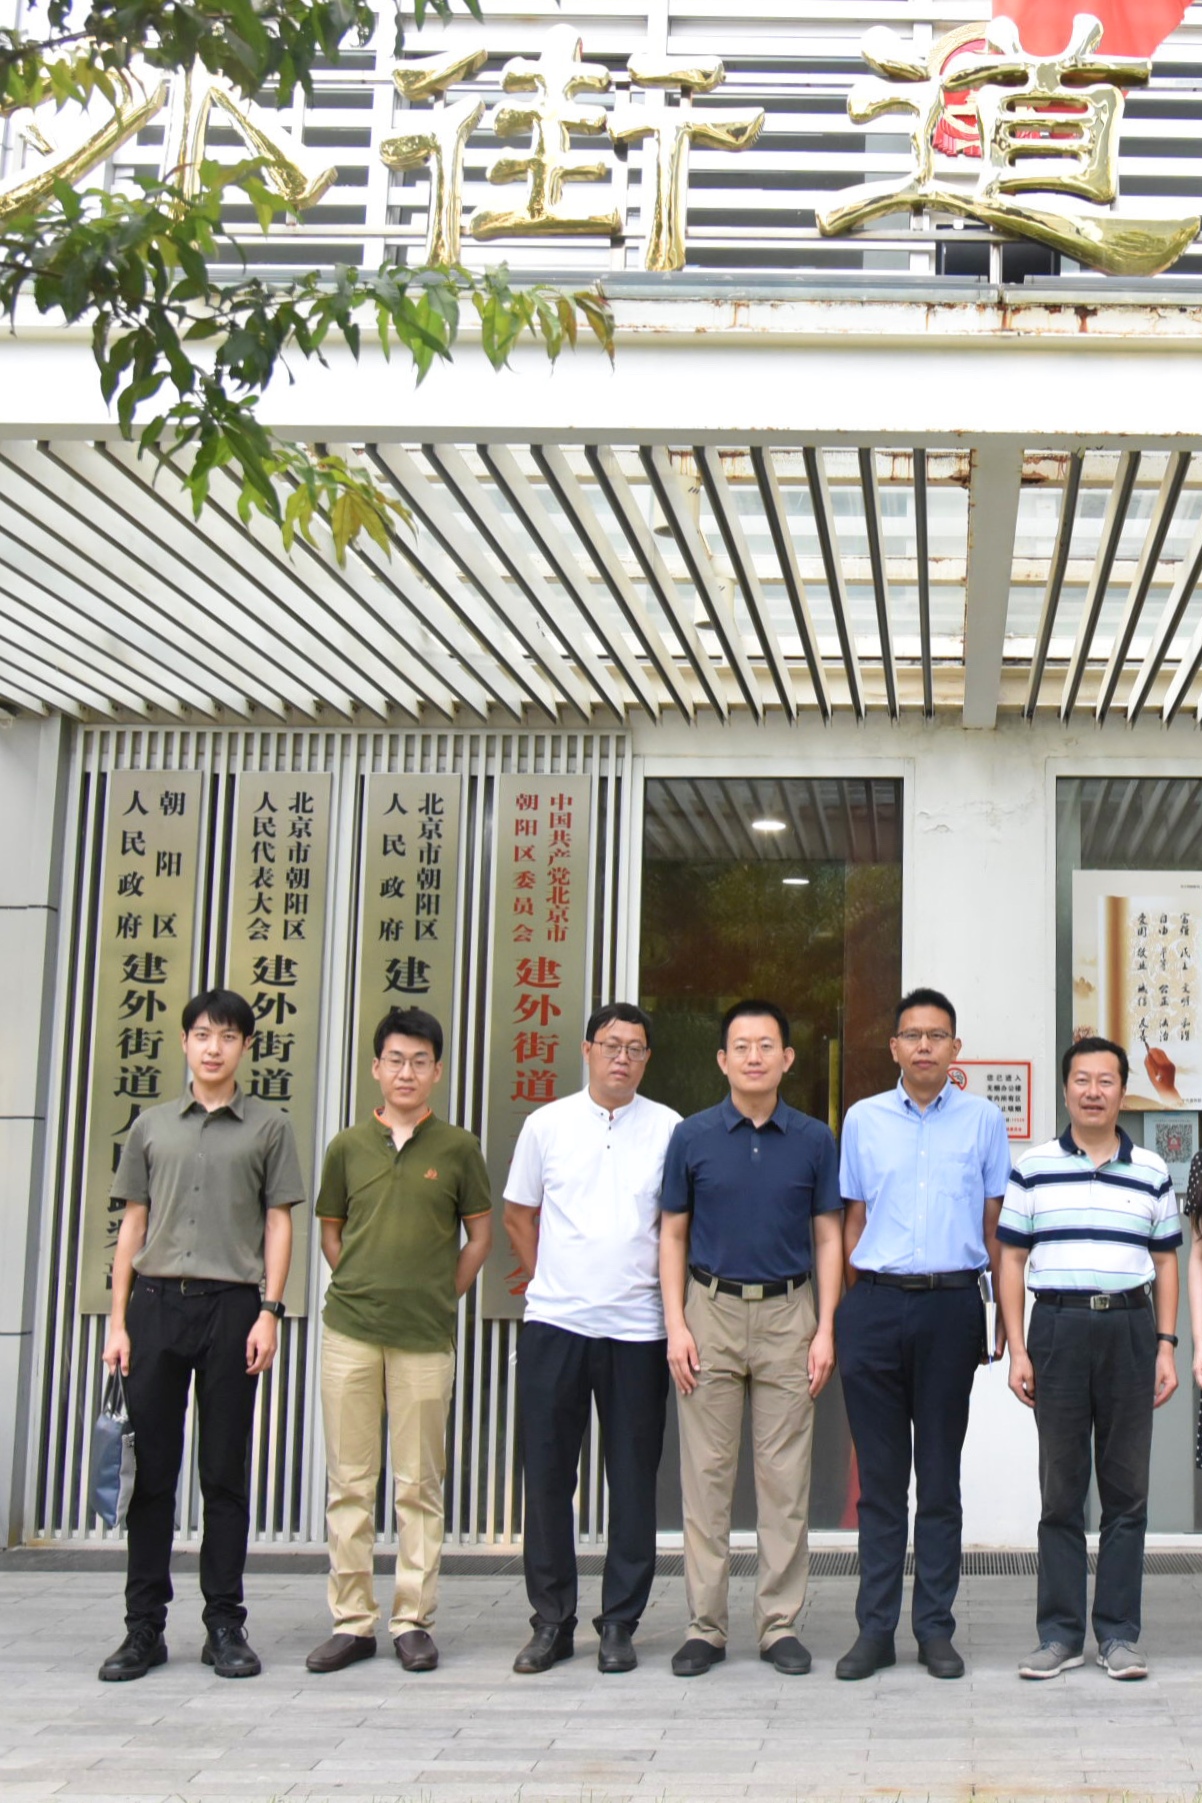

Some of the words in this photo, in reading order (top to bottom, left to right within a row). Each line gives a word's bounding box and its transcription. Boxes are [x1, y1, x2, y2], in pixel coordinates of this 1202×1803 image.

[115, 790, 149, 939] 人民政府
[153, 790, 186, 939] 朝阳区
[247, 791, 278, 941] 人民代表大会
[283, 791, 314, 941] 北京市朝阳区
[378, 792, 408, 942] 人民政府
[414, 792, 444, 942] 北京市朝阳区
[512, 793, 539, 943] 朝阳区委员会
[546, 793, 572, 943] 中国共产党北京市
